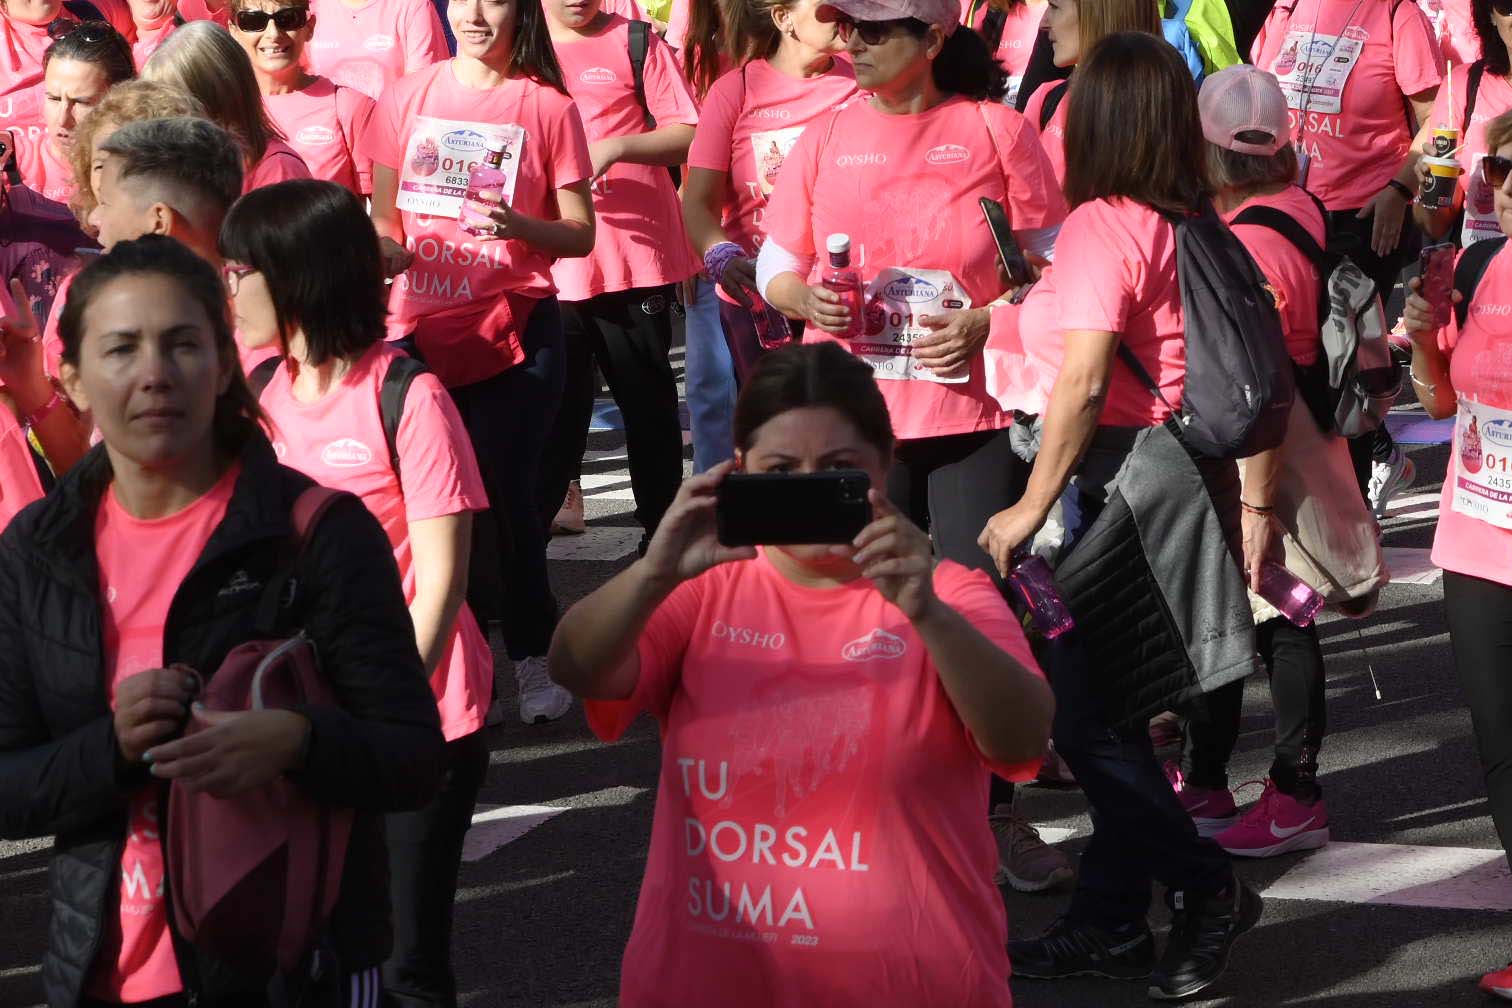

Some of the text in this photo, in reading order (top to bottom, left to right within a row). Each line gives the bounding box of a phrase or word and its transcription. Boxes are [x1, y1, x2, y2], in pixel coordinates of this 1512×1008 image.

[446, 135, 485, 148] ASTURIANA
[836, 152, 887, 167] OYSHO
[406, 237, 511, 270] DORSAL
[400, 271, 473, 299] SUMA
[887, 285, 935, 298] ASTURIANA
[890, 312, 929, 327] 01
[1465, 482, 1489, 499] CARRERA
[1490, 490, 1498, 500] DE
[1499, 492, 1507, 502] LA
[712, 620, 785, 650] OYSHO
[677, 758, 728, 801] TU
[684, 817, 870, 872] DORSAL
[688, 876, 814, 930] SUMA
